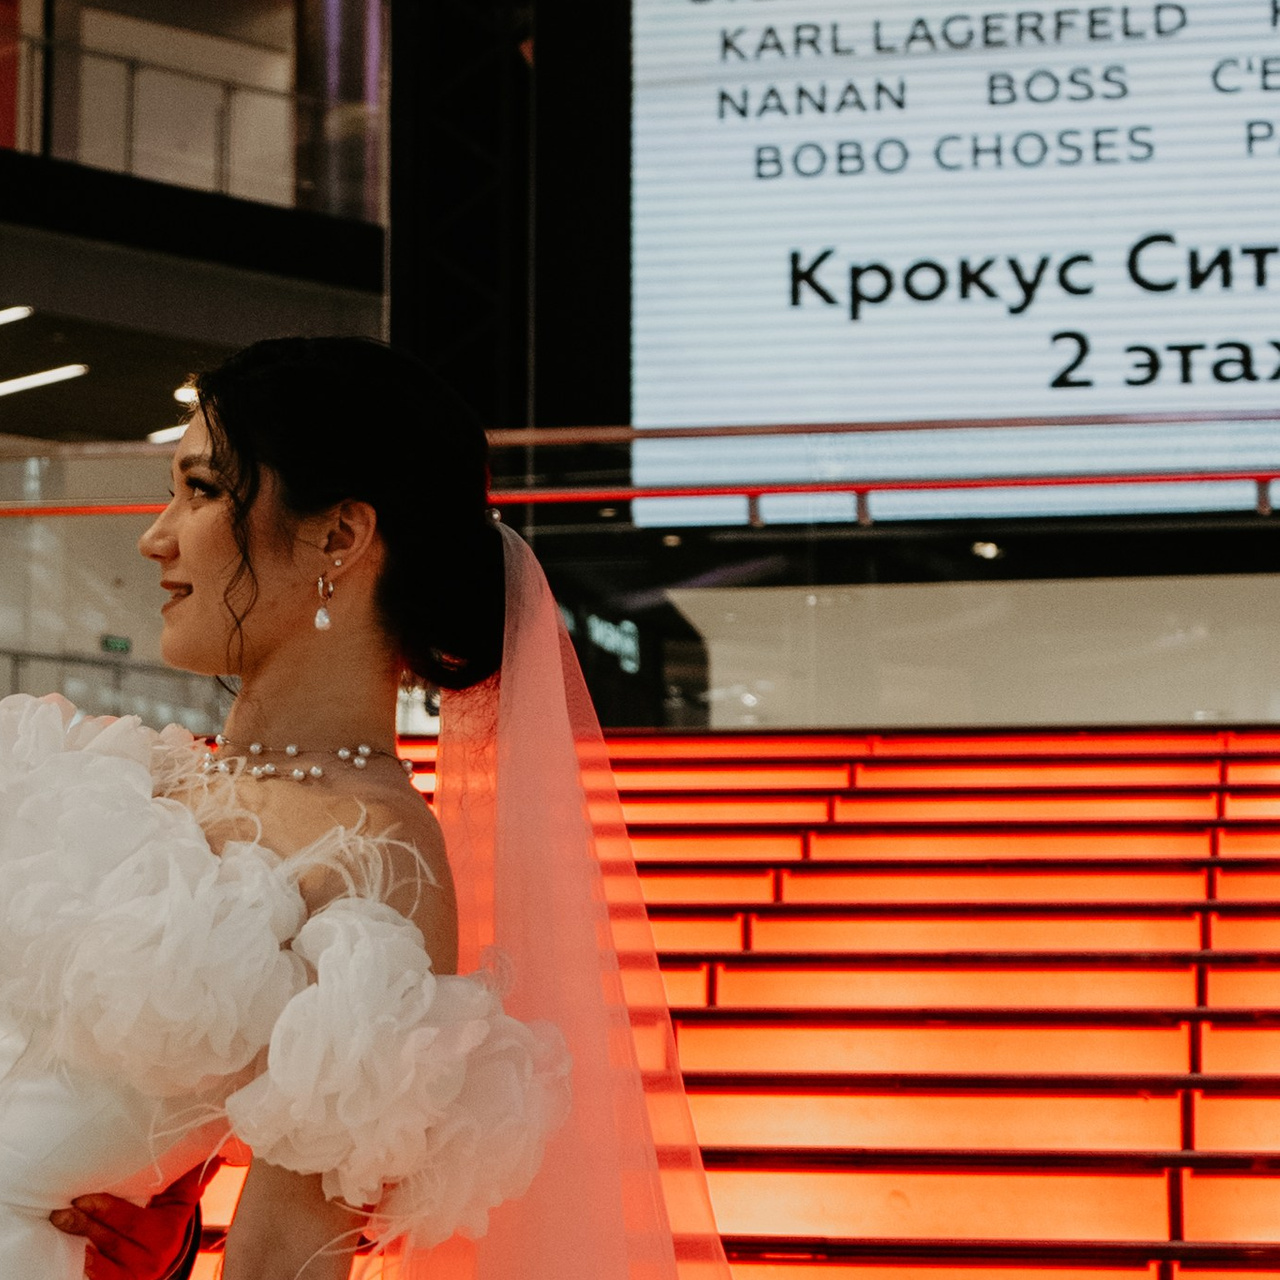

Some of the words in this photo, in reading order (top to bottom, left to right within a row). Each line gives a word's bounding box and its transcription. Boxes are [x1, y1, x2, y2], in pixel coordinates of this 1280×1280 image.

[719, 22, 854, 61] KARL
[872, 2, 1189, 55] LAGERFELD
[717, 80, 907, 120] NANAN
[986, 65, 1130, 107] BOSS
[754, 138, 911, 181] BOBO
[933, 125, 1155, 172] CHOSES
[788, 249, 1095, 322] Крокус
[1125, 232, 1280, 295] Сит
[1049, 330, 1094, 390] 2
[1123, 339, 1280, 388] эта
